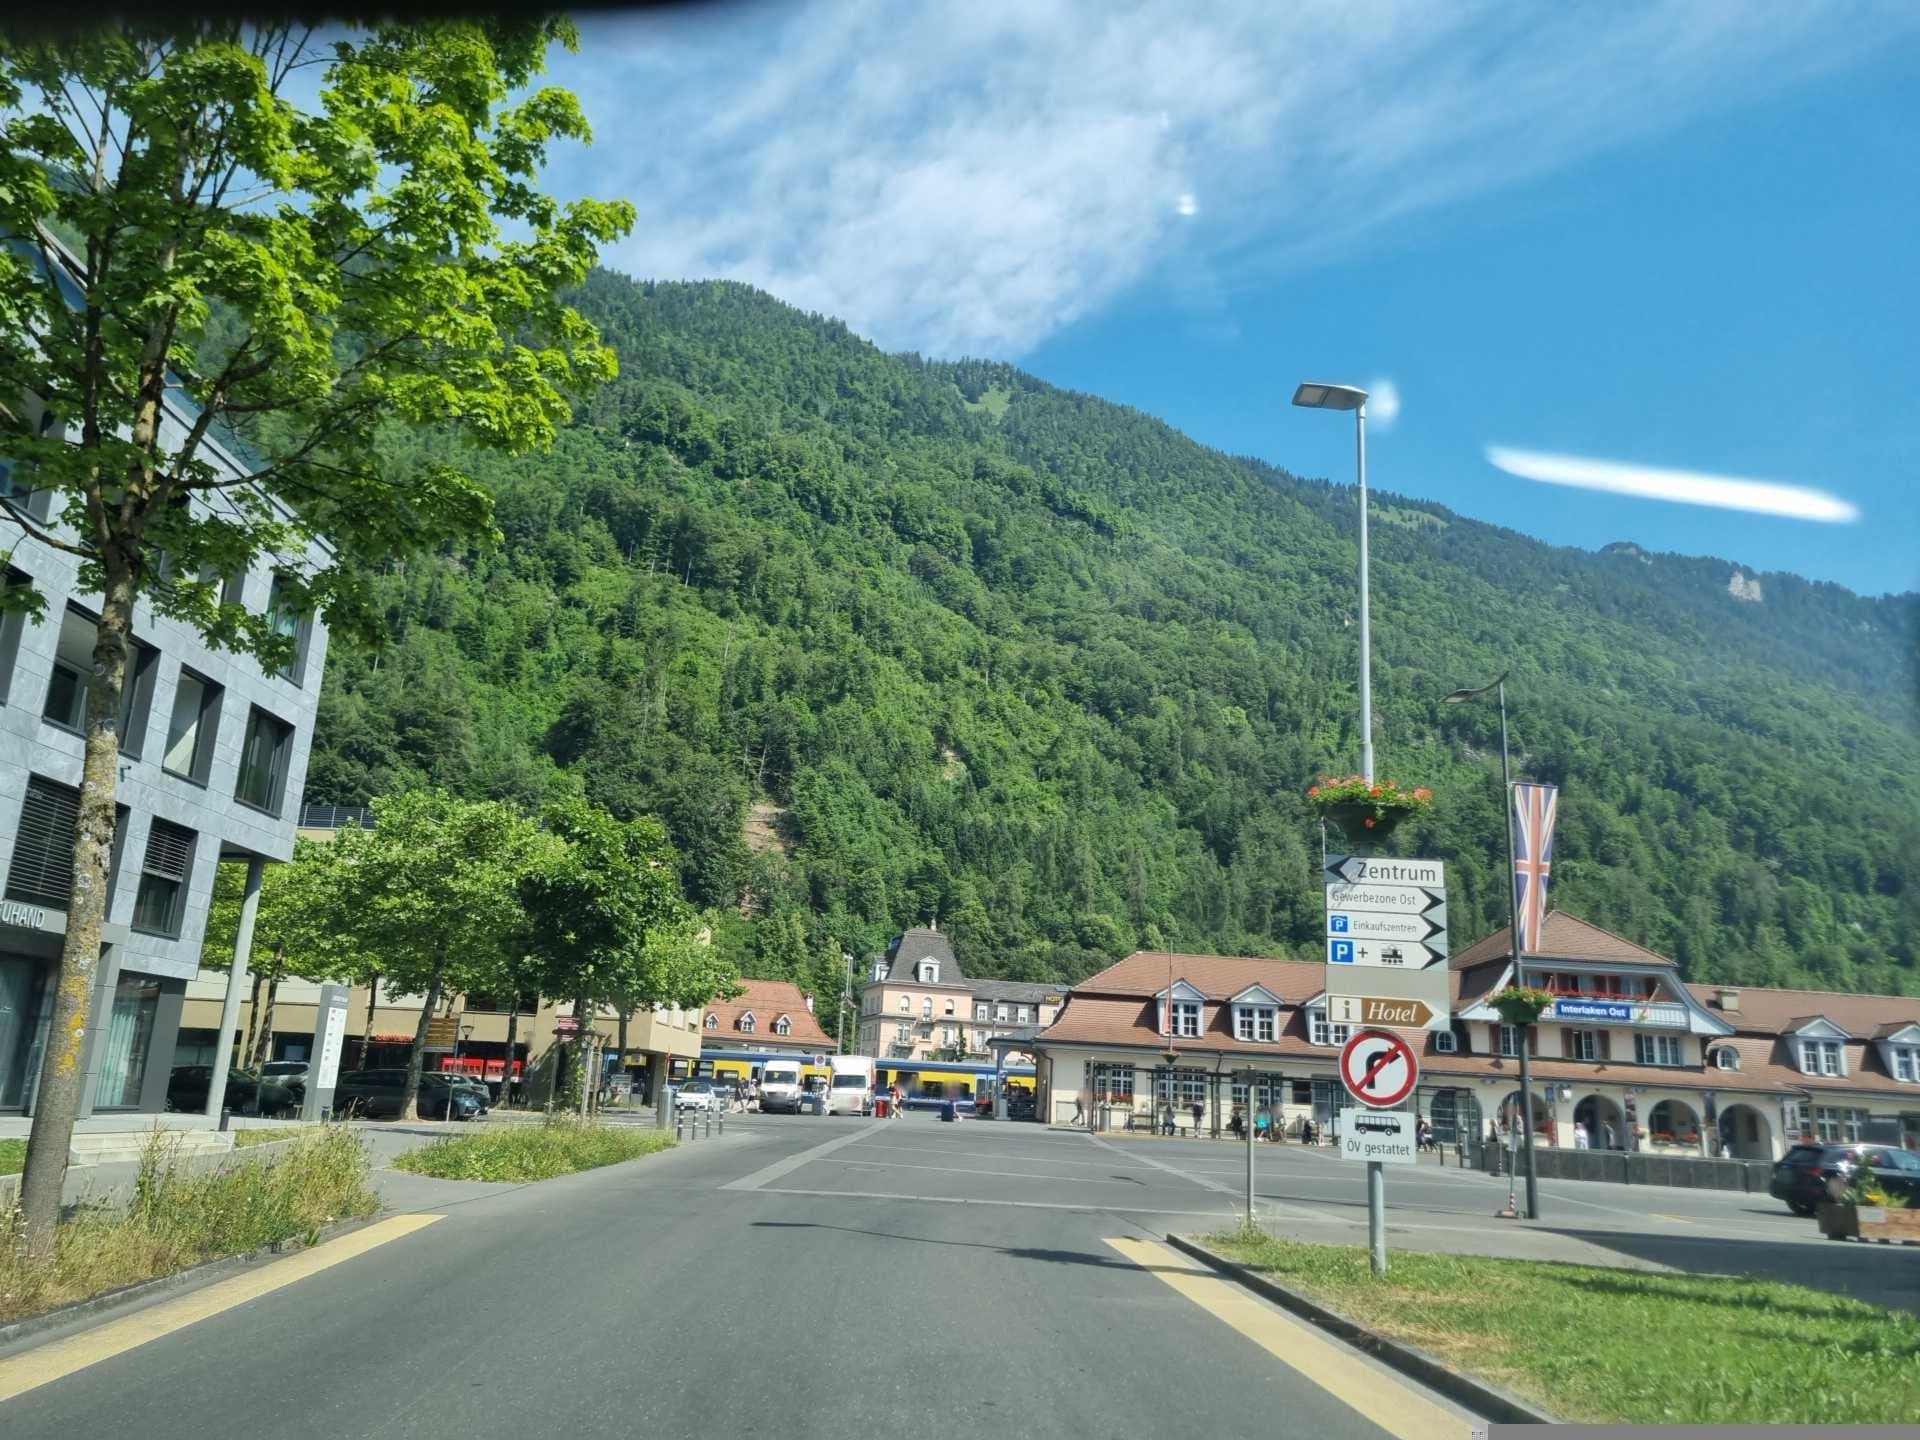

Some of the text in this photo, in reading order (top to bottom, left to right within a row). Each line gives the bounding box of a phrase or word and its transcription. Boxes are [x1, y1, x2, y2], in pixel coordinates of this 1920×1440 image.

[1357, 861, 1436, 882] Zentrum
[1332, 890, 1416, 905] Gewerbezone Ost
[1353, 919, 1417, 933] Einkaufszentren
[1368, 1002, 1417, 1022] Hotel
[1561, 1004, 1606, 1016] Interlaken
[1609, 1007, 1626, 1018] Ost
[1346, 1138, 1411, 1156] ÖV gestattet
